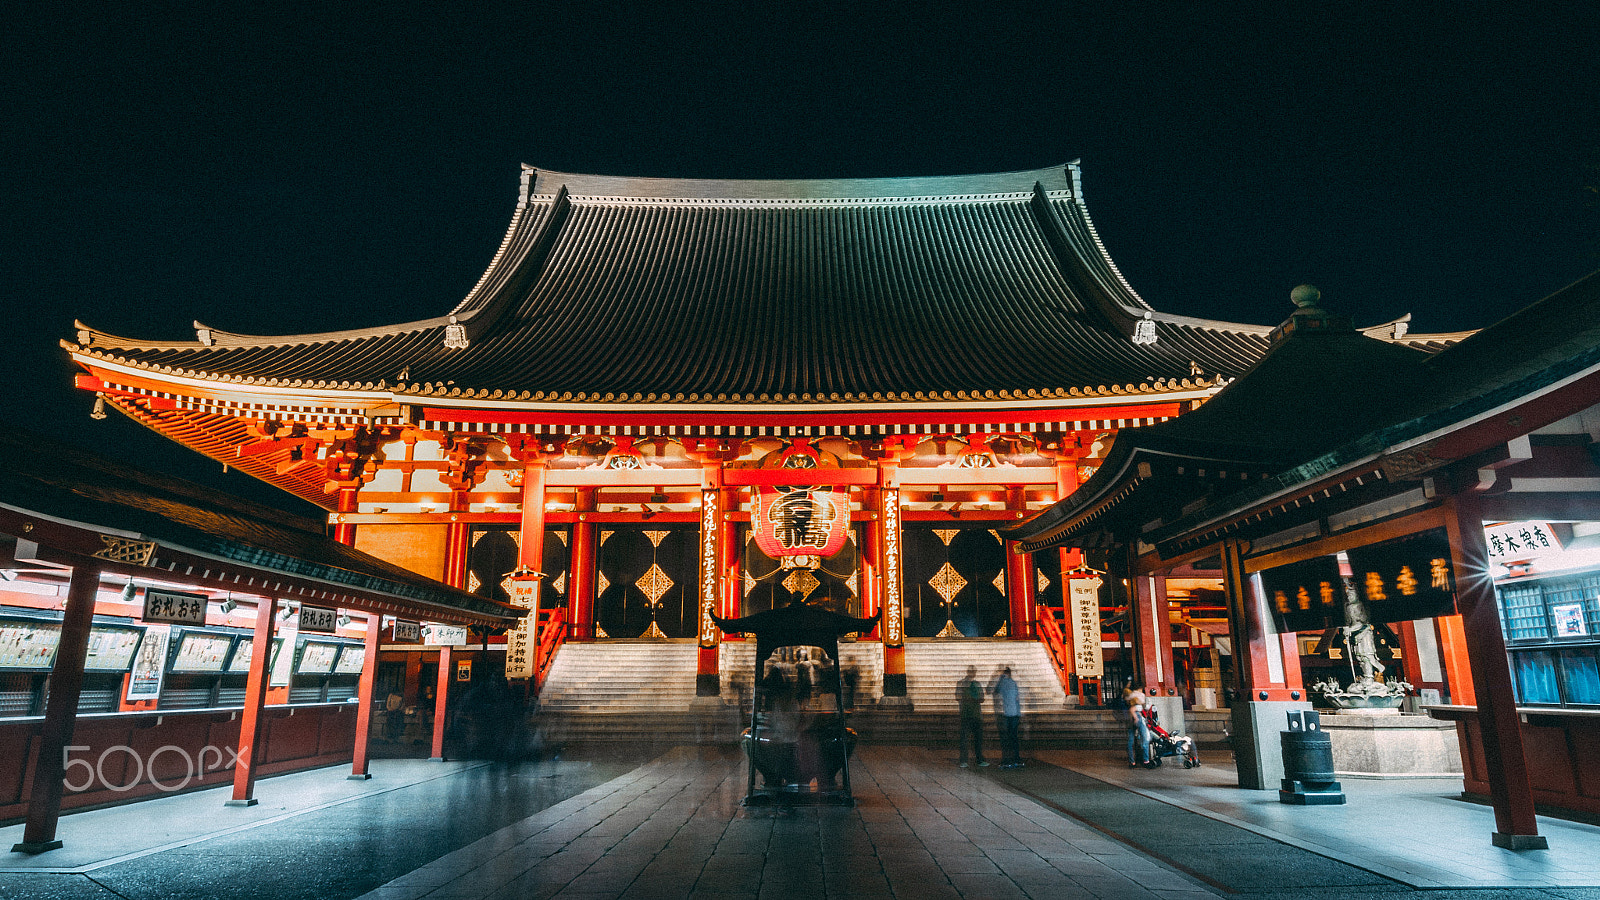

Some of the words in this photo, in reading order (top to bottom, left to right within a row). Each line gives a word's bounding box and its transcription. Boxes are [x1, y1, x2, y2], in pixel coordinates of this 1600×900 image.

[149, 596, 200, 619] お札お守
[302, 609, 333, 628] お札お守
[396, 625, 420, 641] お札お守
